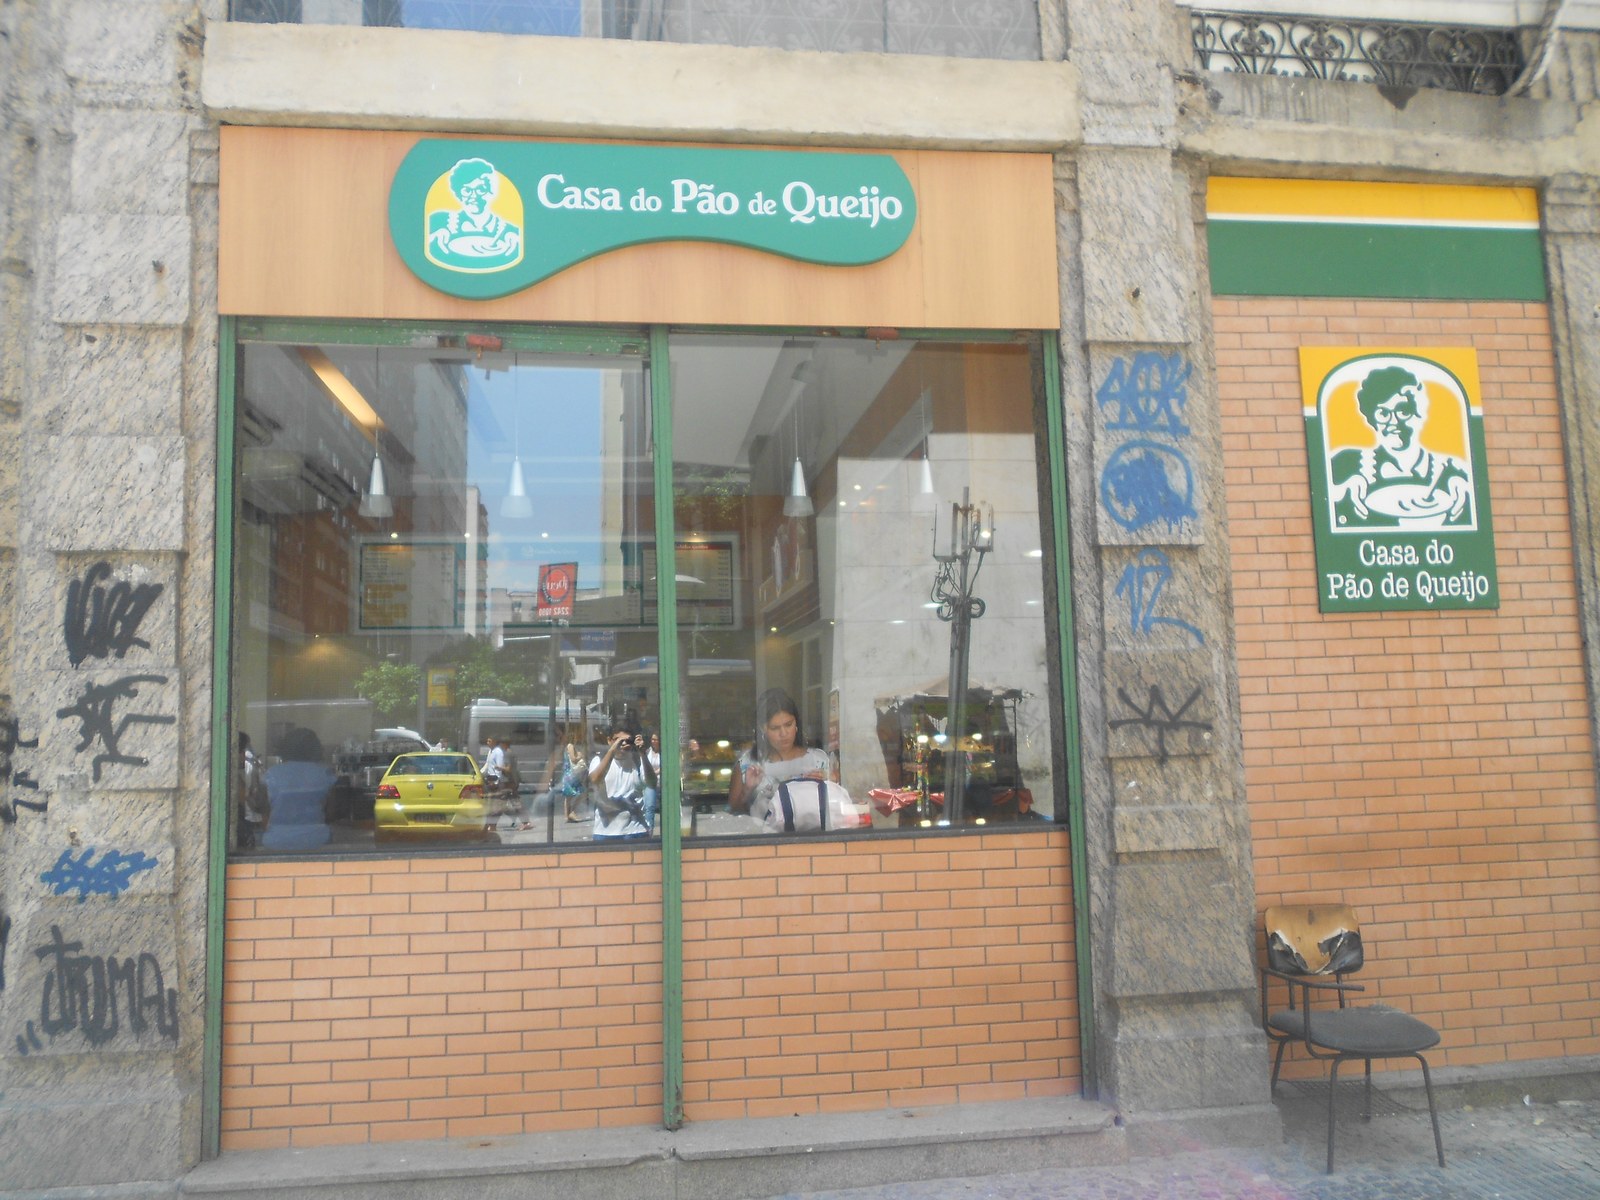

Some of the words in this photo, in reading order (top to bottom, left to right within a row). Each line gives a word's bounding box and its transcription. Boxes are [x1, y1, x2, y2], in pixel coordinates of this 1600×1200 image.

[537, 173, 623, 211] Casa
[629, 187, 662, 212] do
[671, 178, 740, 215] Pão
[748, 191, 777, 215] de
[781, 180, 903, 228] Queijo
[1359, 539, 1420, 566] Casa
[1425, 539, 1454, 565] do
[1326, 573, 1374, 599] Pão
[1381, 572, 1409, 598] de
[1416, 571, 1489, 603] Queijo
